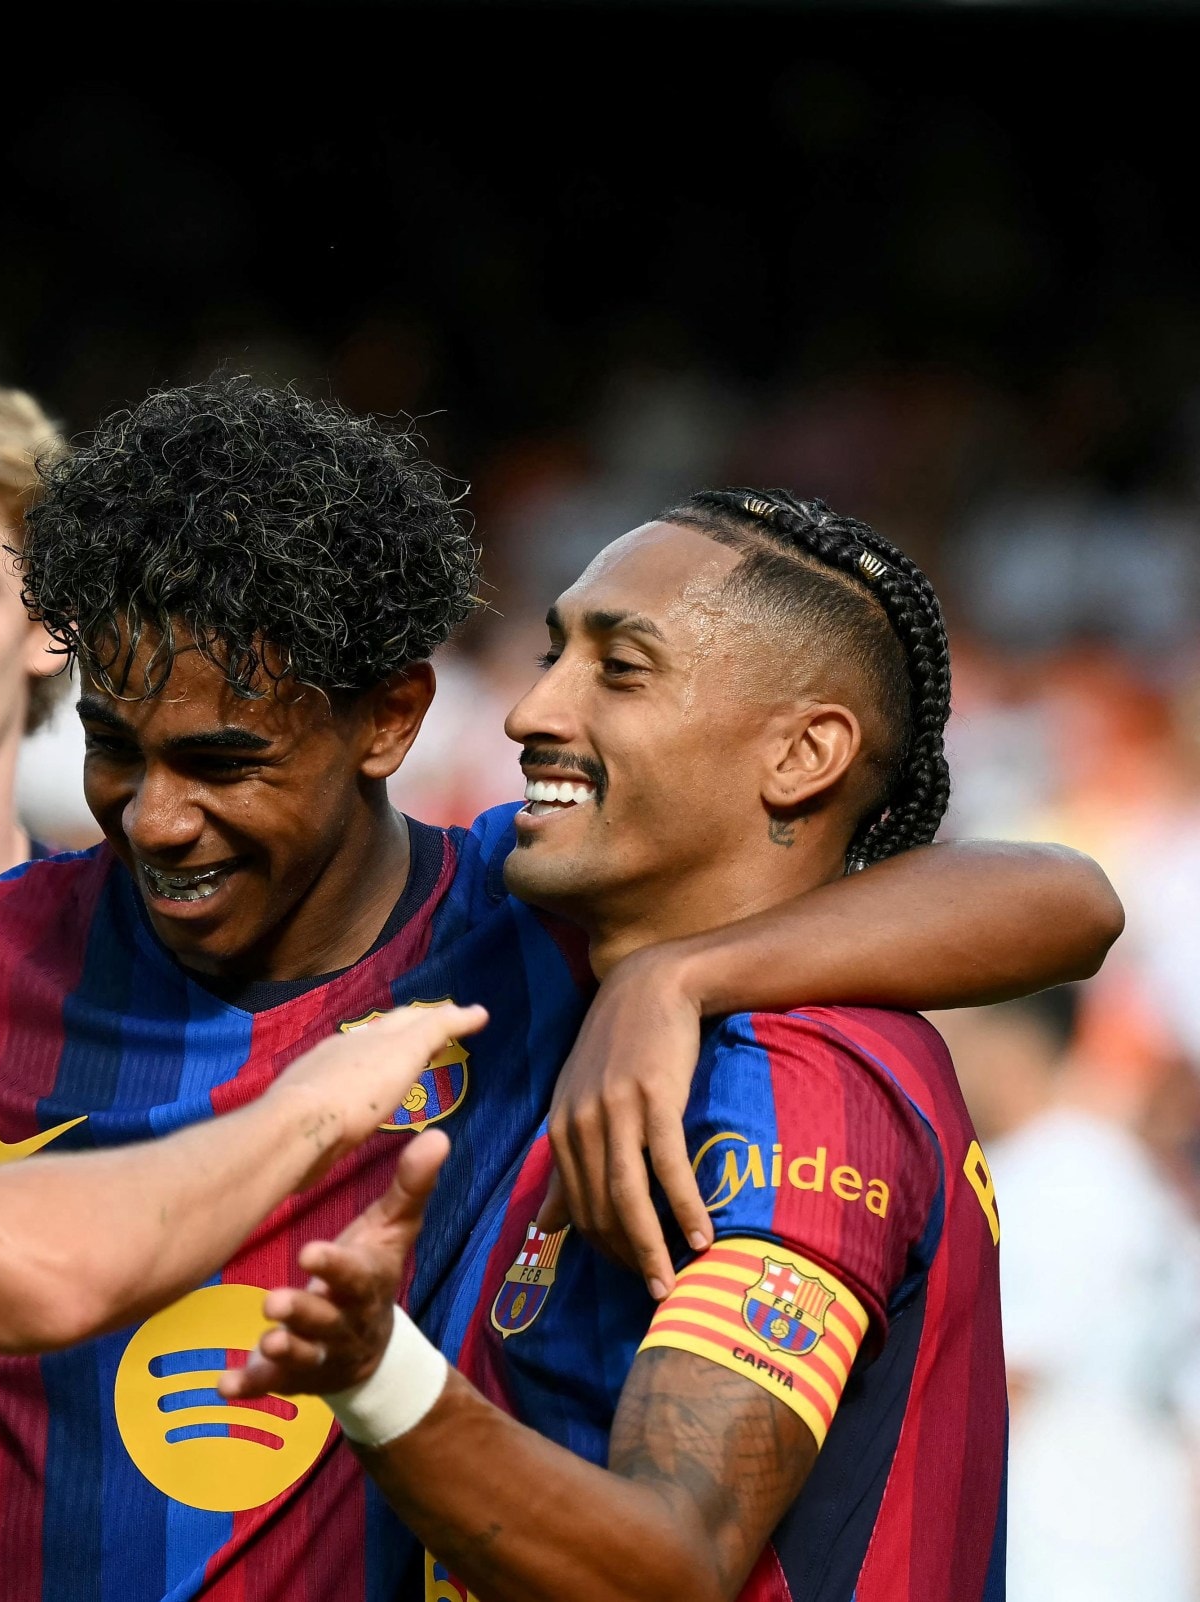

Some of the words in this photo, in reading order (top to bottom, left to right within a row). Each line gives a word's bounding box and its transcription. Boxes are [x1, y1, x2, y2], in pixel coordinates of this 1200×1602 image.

[692, 1132, 890, 1219] Midea
[519, 1268, 542, 1283] FCB
[772, 1297, 804, 1320] FCB
[732, 1346, 794, 1391] CAPITÀ
